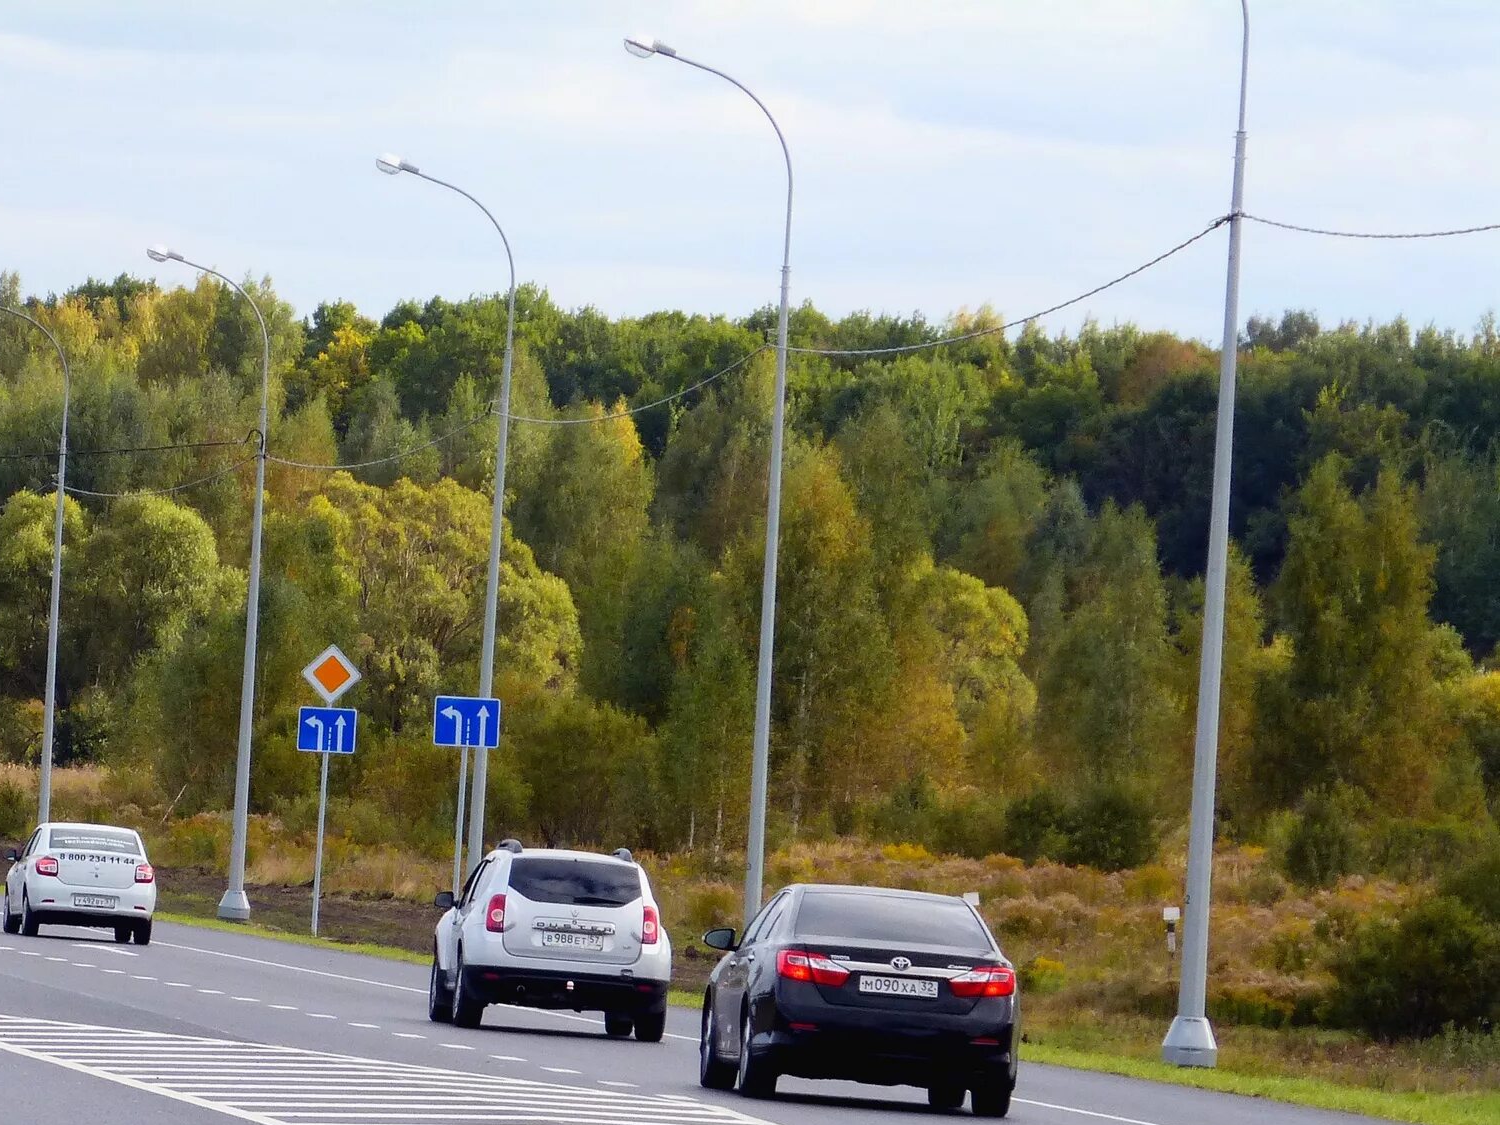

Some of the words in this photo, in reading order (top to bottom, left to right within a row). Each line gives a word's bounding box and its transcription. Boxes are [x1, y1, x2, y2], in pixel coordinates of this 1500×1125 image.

[68, 853, 86, 861] 800
[88, 855, 106, 863] 234
[110, 856, 120, 864] 11
[920, 981, 934, 991] 32
